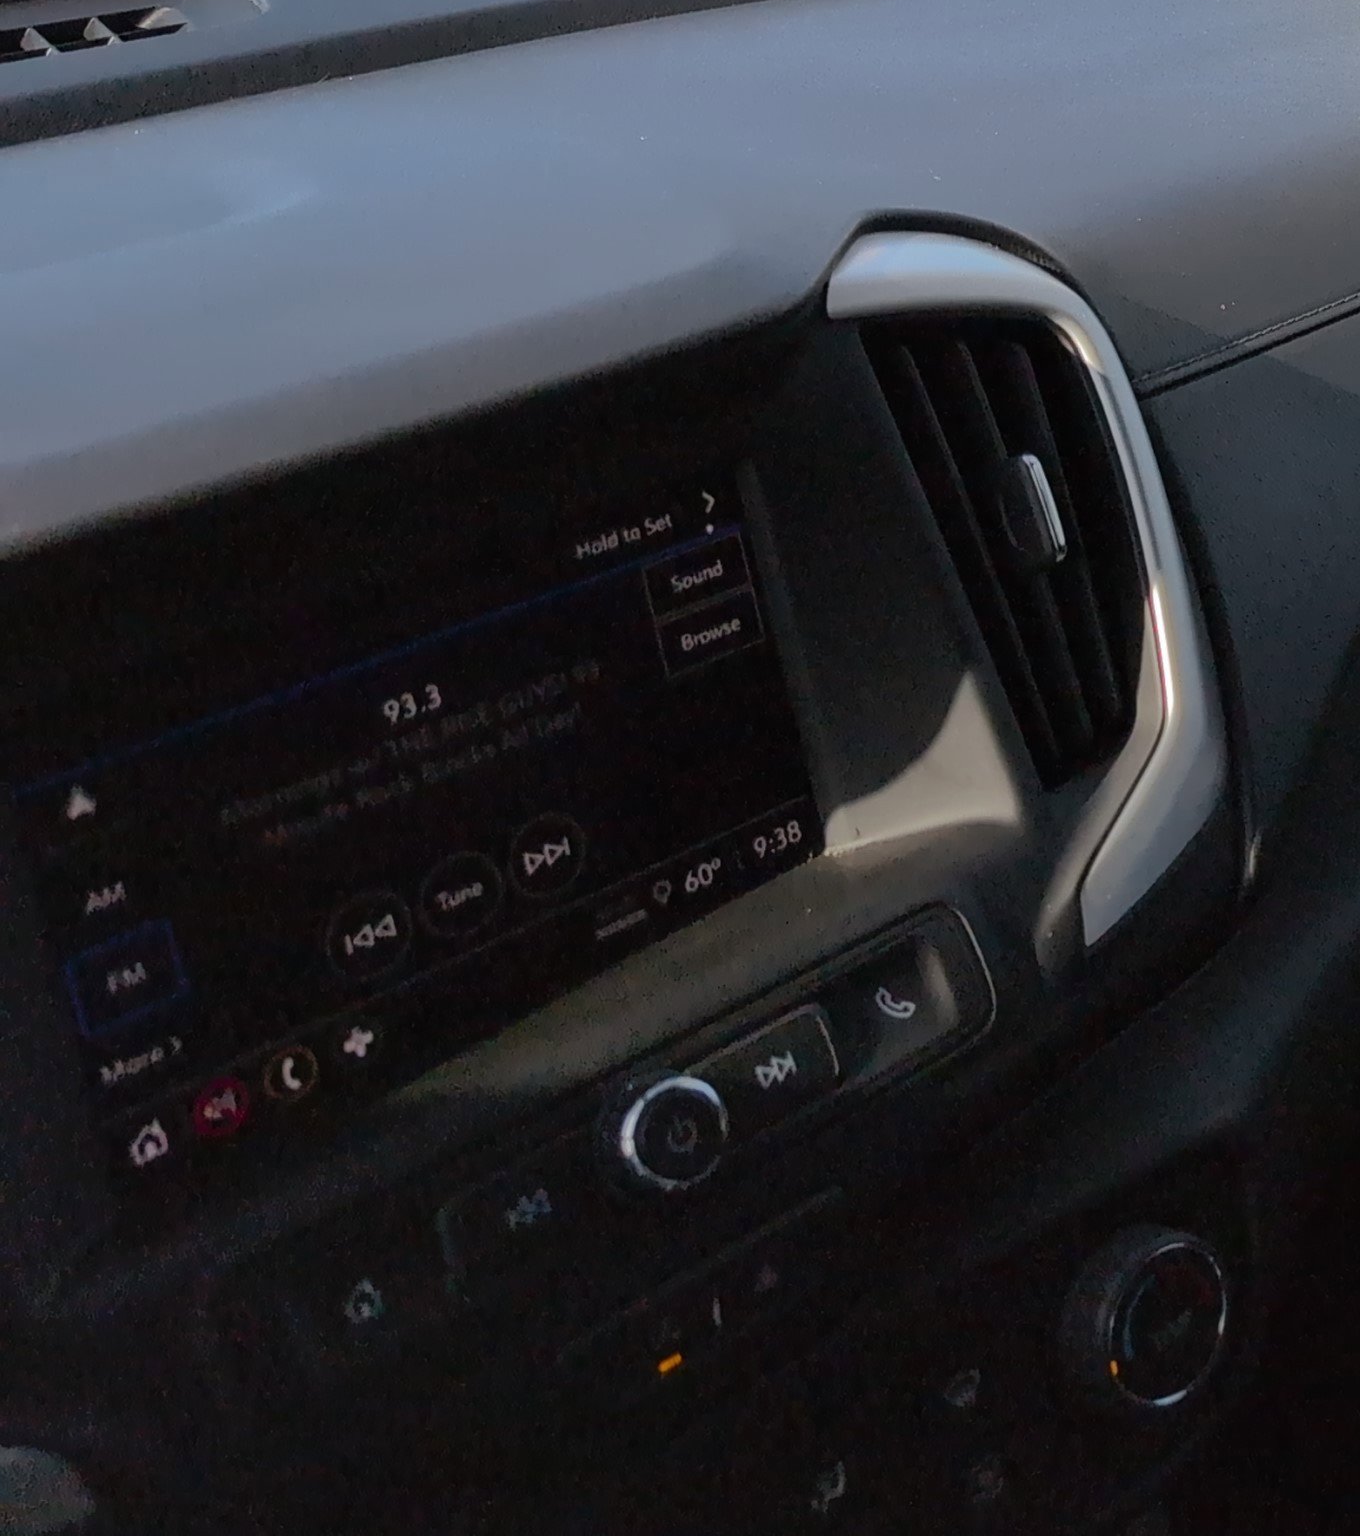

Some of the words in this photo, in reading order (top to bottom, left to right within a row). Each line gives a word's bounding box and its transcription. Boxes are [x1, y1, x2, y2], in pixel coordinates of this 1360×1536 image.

[575, 531, 619, 560] Hold
[622, 526, 641, 544] to
[643, 512, 673, 537] Set
[670, 559, 724, 593] Sound
[680, 617, 742, 652] Browse
[381, 682, 443, 724] 93.3
[751, 819, 803, 860] 9:38
[434, 880, 484, 911] Tune
